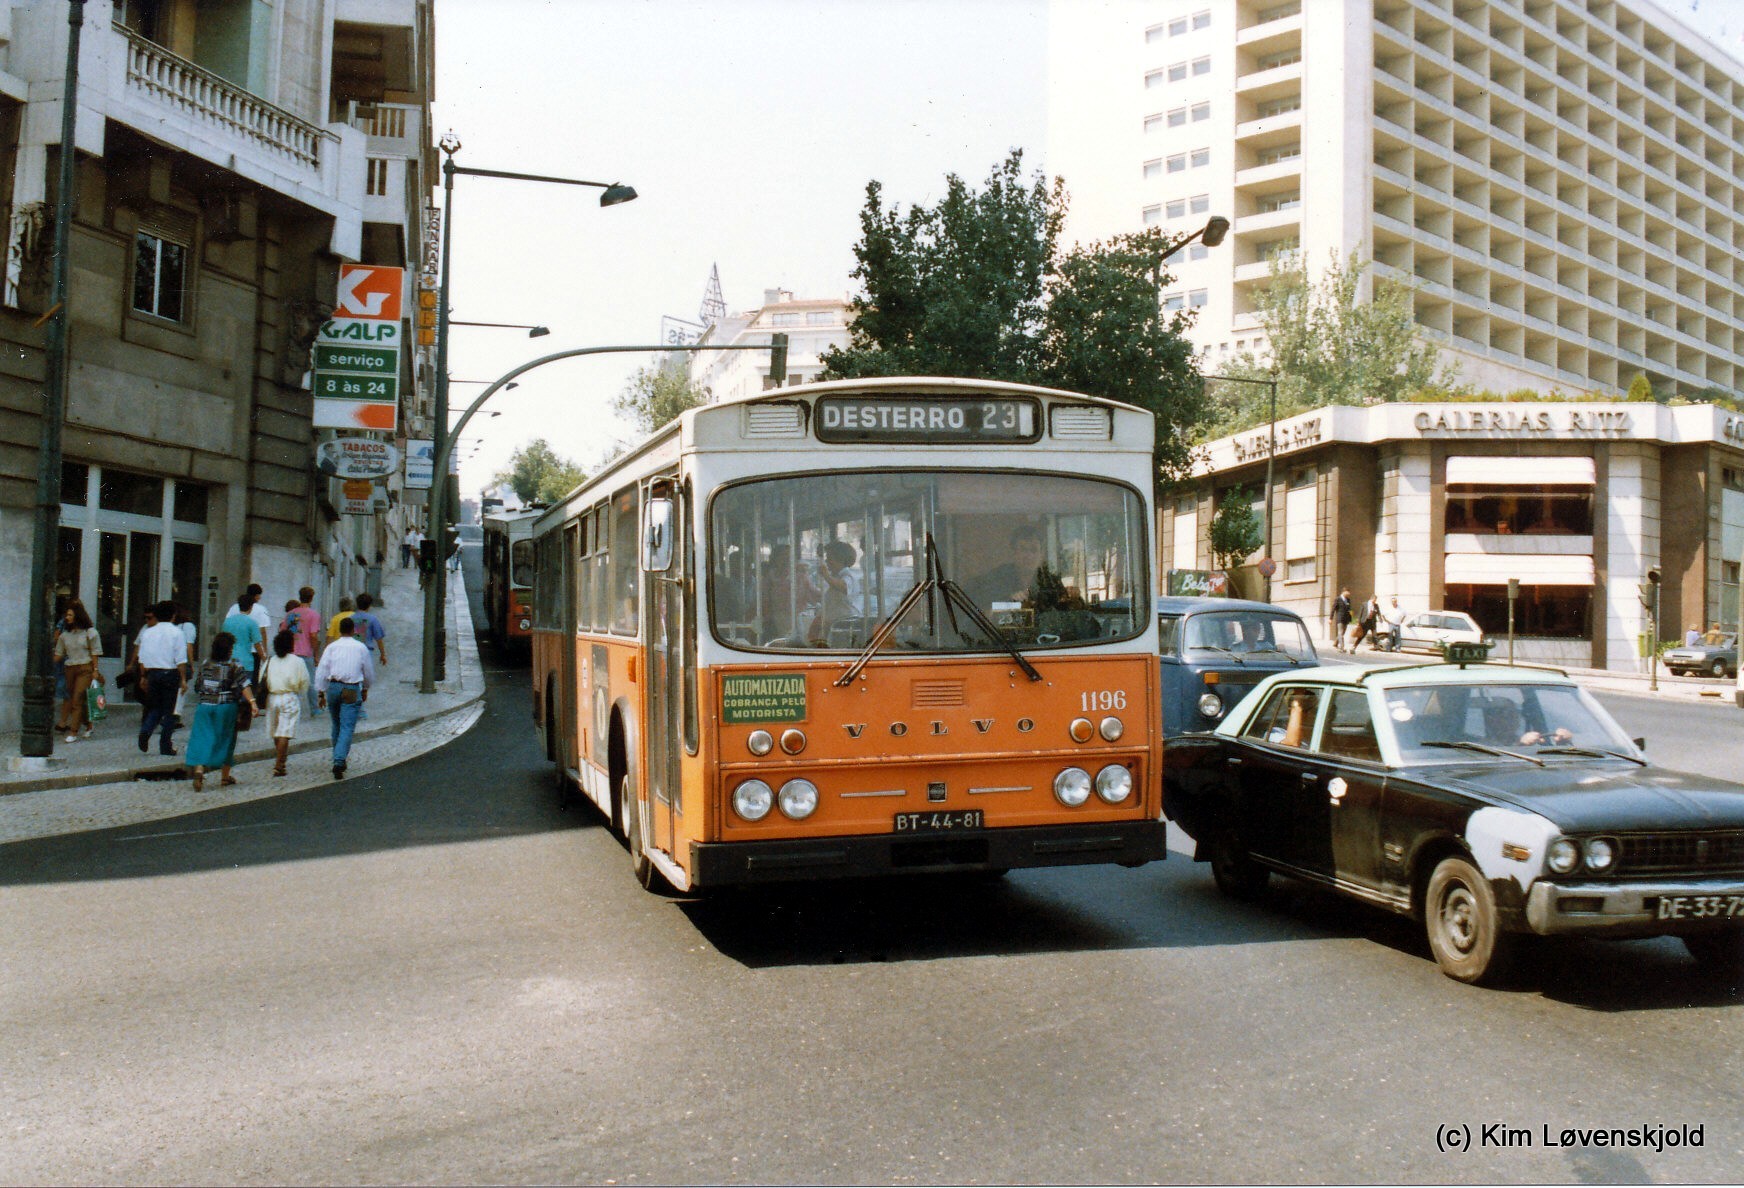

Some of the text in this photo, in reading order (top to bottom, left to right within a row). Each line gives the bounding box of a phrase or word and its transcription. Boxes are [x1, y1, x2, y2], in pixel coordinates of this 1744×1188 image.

[320, 320, 397, 341] GALP
[329, 354, 384, 368] serviço
[326, 380, 386, 394] 8 às 24
[823, 403, 1016, 430] DESTERRO 23
[1414, 409, 1630, 431] GALERIAS RITZ
[341, 442, 386, 452] TABACOS
[1454, 647, 1484, 657] TAXI
[724, 679, 805, 696] AUTOMATIZADA
[782, 698, 805, 706] PELO
[1081, 690, 1127, 712] 1196
[732, 708, 796, 718] MOTORISTA
[842, 718, 1035, 738] VOLVO
[896, 812, 981, 831] BT-44-81
